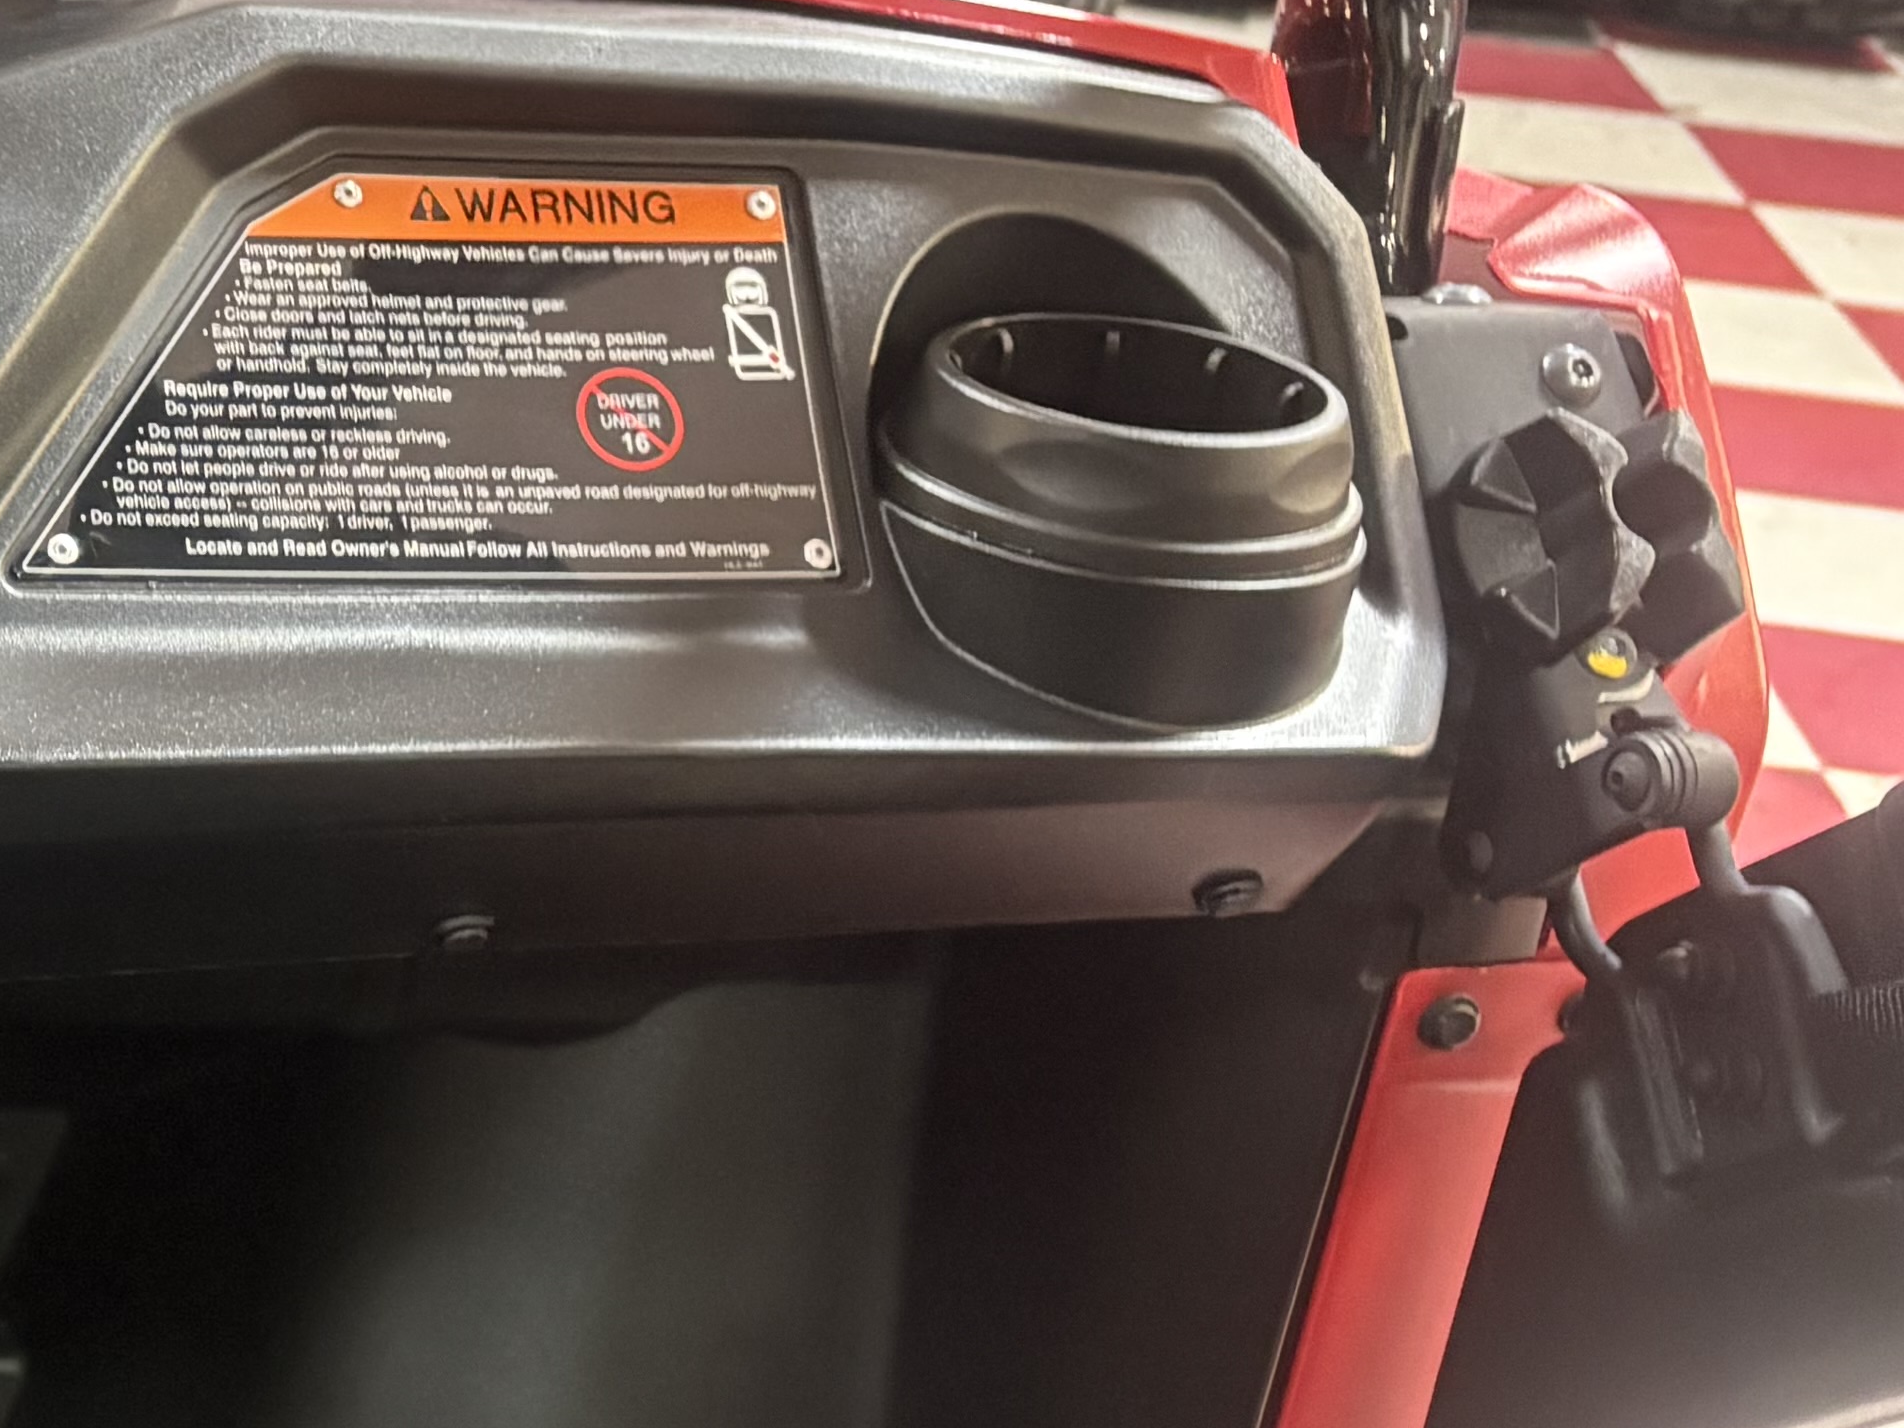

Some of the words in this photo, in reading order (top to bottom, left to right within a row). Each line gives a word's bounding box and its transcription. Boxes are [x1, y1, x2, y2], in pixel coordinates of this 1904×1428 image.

[454, 187, 676, 225] WARNING
[245, 241, 313, 260] Improper
[317, 242, 346, 259] Use
[350, 243, 365, 259] of
[368, 244, 459, 264] Off-Highway
[462, 245, 524, 262] Vehicles
[528, 245, 559, 262] Can
[562, 246, 610, 263] Cause
[612, 246, 665, 263] Severe
[667, 247, 710, 265] Injury
[714, 250, 729, 263] or
[733, 246, 778, 264] Death
[239, 257, 264, 275] Be
[266, 259, 342, 278] Prepared
[244, 276, 294, 292] Fasten
[297, 278, 328, 292] seat
[332, 278, 372, 294] belts.
[233, 290, 272, 306] Wear
[276, 293, 295, 306] an
[298, 292, 369, 309] approved
[372, 292, 421, 309] helmet
[424, 294, 453, 310] and
[455, 295, 529, 314] protective
[532, 298, 568, 315] gear.
[223, 306, 267, 321] Close
[271, 306, 314, 323] doors
[317, 307, 346, 323] and
[348, 308, 385, 324] latch
[388, 310, 420, 324] nets
[423, 310, 471, 326] before
[474, 312, 528, 330] driving.
[163, 378, 229, 400] Require
[233, 380, 290, 403] Proper
[293, 382, 326, 400] Use
[330, 383, 347, 401] of
[351, 383, 388, 402] Your
[392, 384, 452, 403] Vehicle
[596, 392, 660, 410] DRIVER
[164, 399, 187, 417] Do
[190, 402, 224, 420] your
[228, 402, 258, 421] part
[261, 403, 277, 419] to
[280, 403, 337, 422] prevent
[339, 404, 398, 424] injuries:
[599, 413, 662, 430] UNDER
[148, 422, 171, 439] Do
[174, 424, 199, 440] not
[202, 424, 241, 440] allow
[244, 426, 308, 442] careless
[311, 429, 326, 443] or
[330, 427, 393, 445] reckless
[395, 427, 451, 448] driving.
[621, 431, 651, 455] 16
[135, 440, 177, 457] Make
[180, 442, 213, 458] sure
[217, 442, 289, 460] operators
[292, 444, 317, 459] are
[321, 444, 340, 460] 16
[342, 446, 359, 461] or
[362, 443, 401, 461] older
[185, 537, 243, 557] Locate
[247, 537, 279, 557] and
[283, 538, 327, 557] Read
[331, 538, 400, 558] Owner's
[403, 540, 464, 558] Manual
[467, 540, 521, 558] Follow
[526, 540, 548, 559] All
[552, 541, 651, 559] Instructions
[655, 541, 686, 559] and
[689, 541, 770, 560] Warnings
